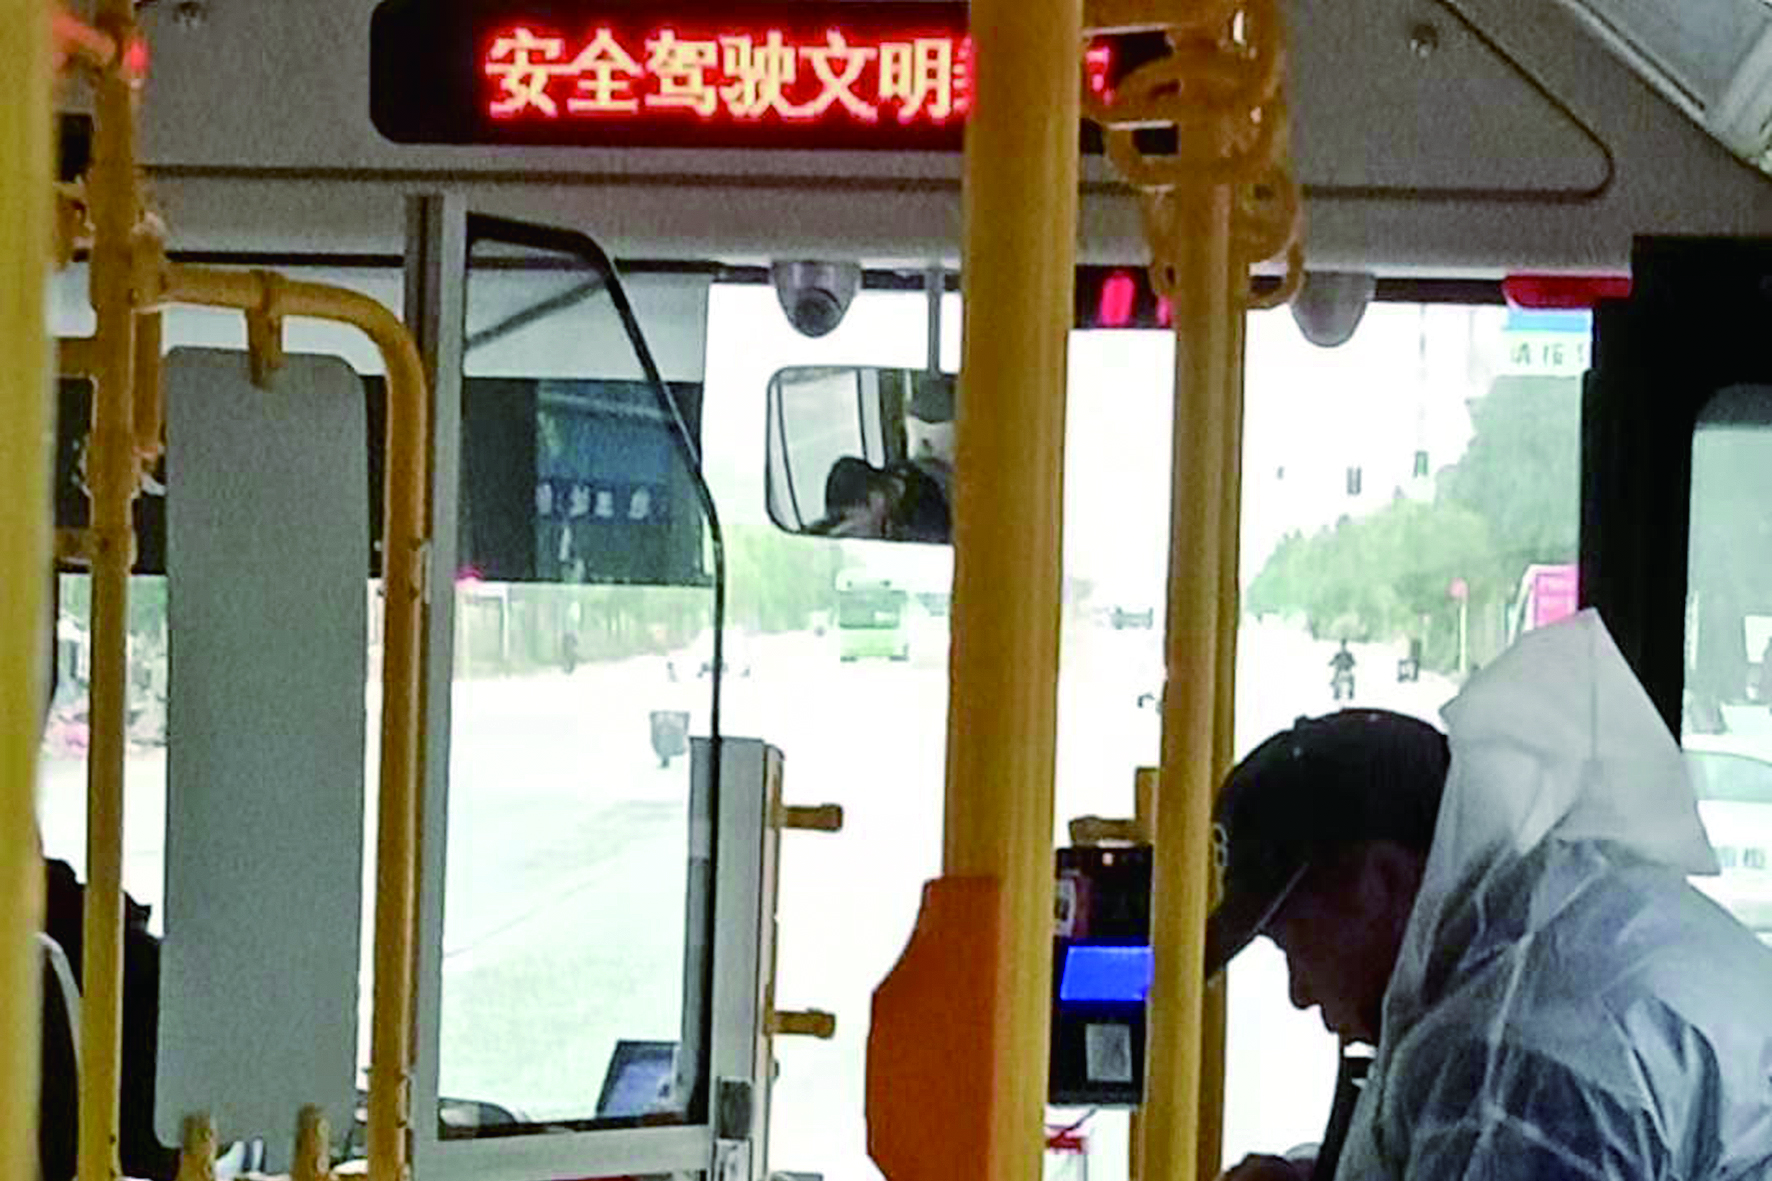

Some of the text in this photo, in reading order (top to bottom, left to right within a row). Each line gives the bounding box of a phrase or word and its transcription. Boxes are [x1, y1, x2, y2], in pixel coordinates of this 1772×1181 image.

[484, 27, 1112, 122] 安全驾驶文明
